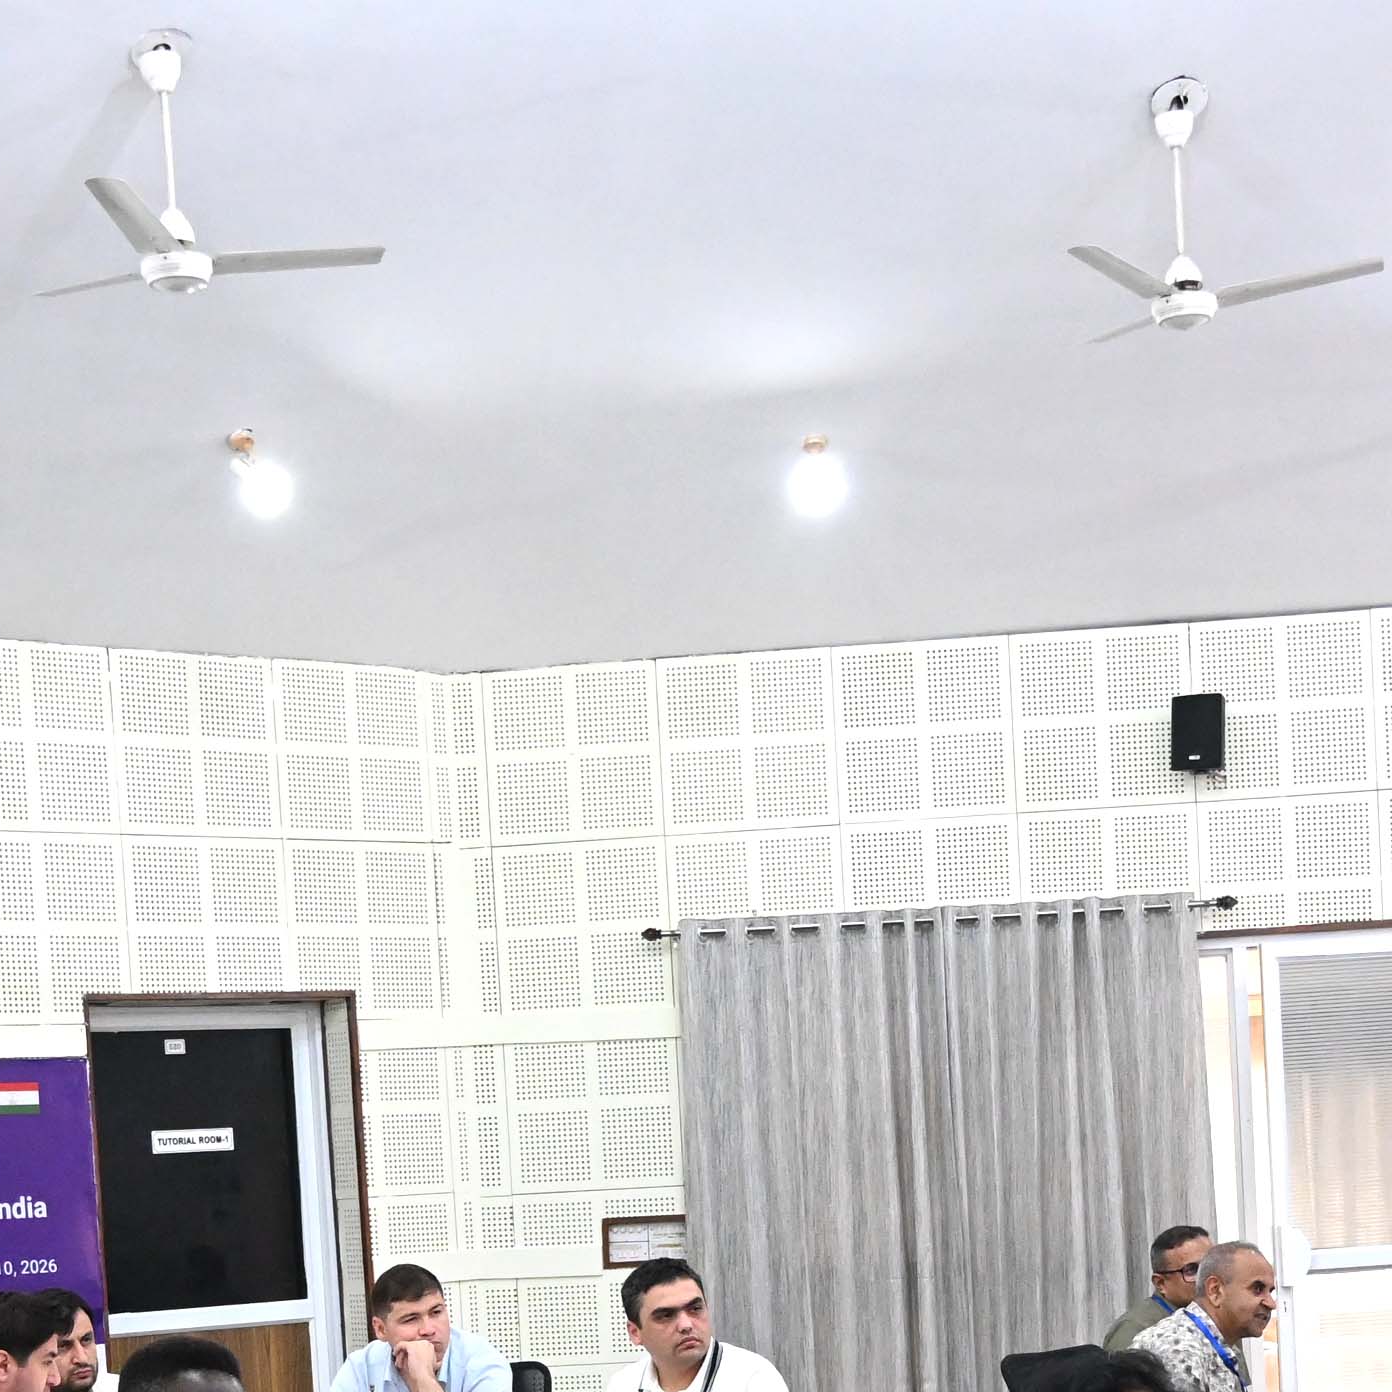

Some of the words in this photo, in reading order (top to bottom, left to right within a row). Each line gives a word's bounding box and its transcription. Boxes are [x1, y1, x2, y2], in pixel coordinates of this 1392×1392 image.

[157, 1137, 196, 1146] TUTORIAL
[198, 1135, 229, 1144] ROOM-1
[21, 1258, 58, 1274] 2026
